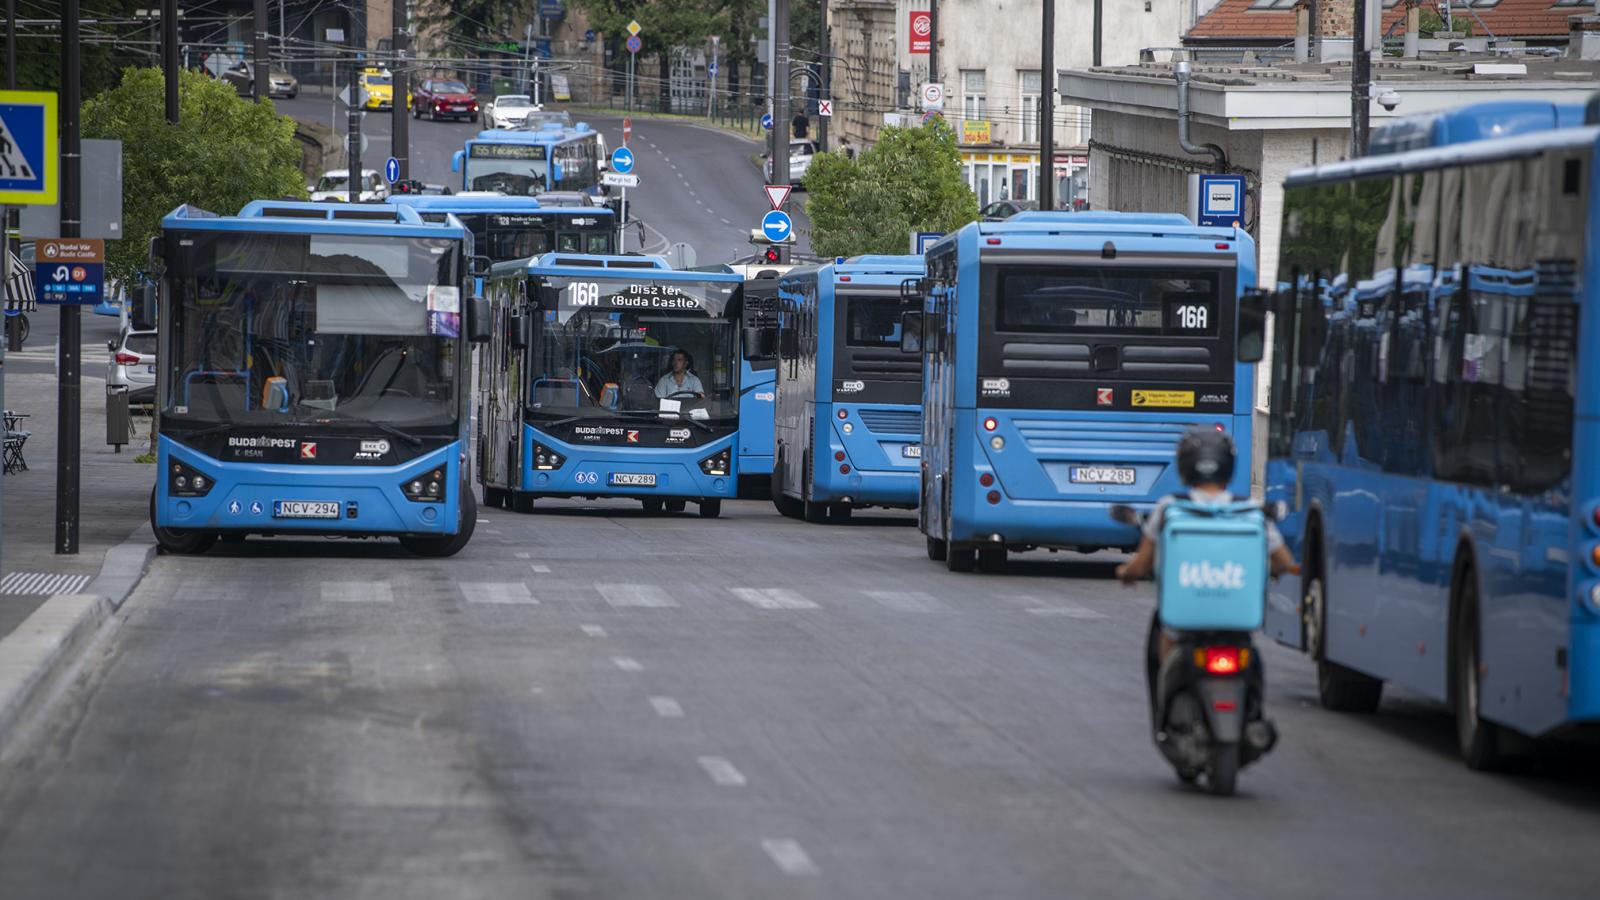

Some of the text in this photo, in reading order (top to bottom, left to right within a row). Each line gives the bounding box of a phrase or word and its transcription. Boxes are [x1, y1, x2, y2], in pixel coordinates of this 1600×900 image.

[568, 282, 599, 306] 16A
[662, 285, 682, 296] tér
[611, 296, 700, 308] (Buda Castle)
[1177, 306, 1207, 329] 16A
[1200, 394, 1228, 404] ATAK
[235, 449, 263, 457] KRSAN
[615, 474, 654, 484] NCV-289
[1079, 468, 1132, 481] NCV-285
[283, 503, 336, 514] NCV-294
[1179, 560, 1245, 590] Wolt
